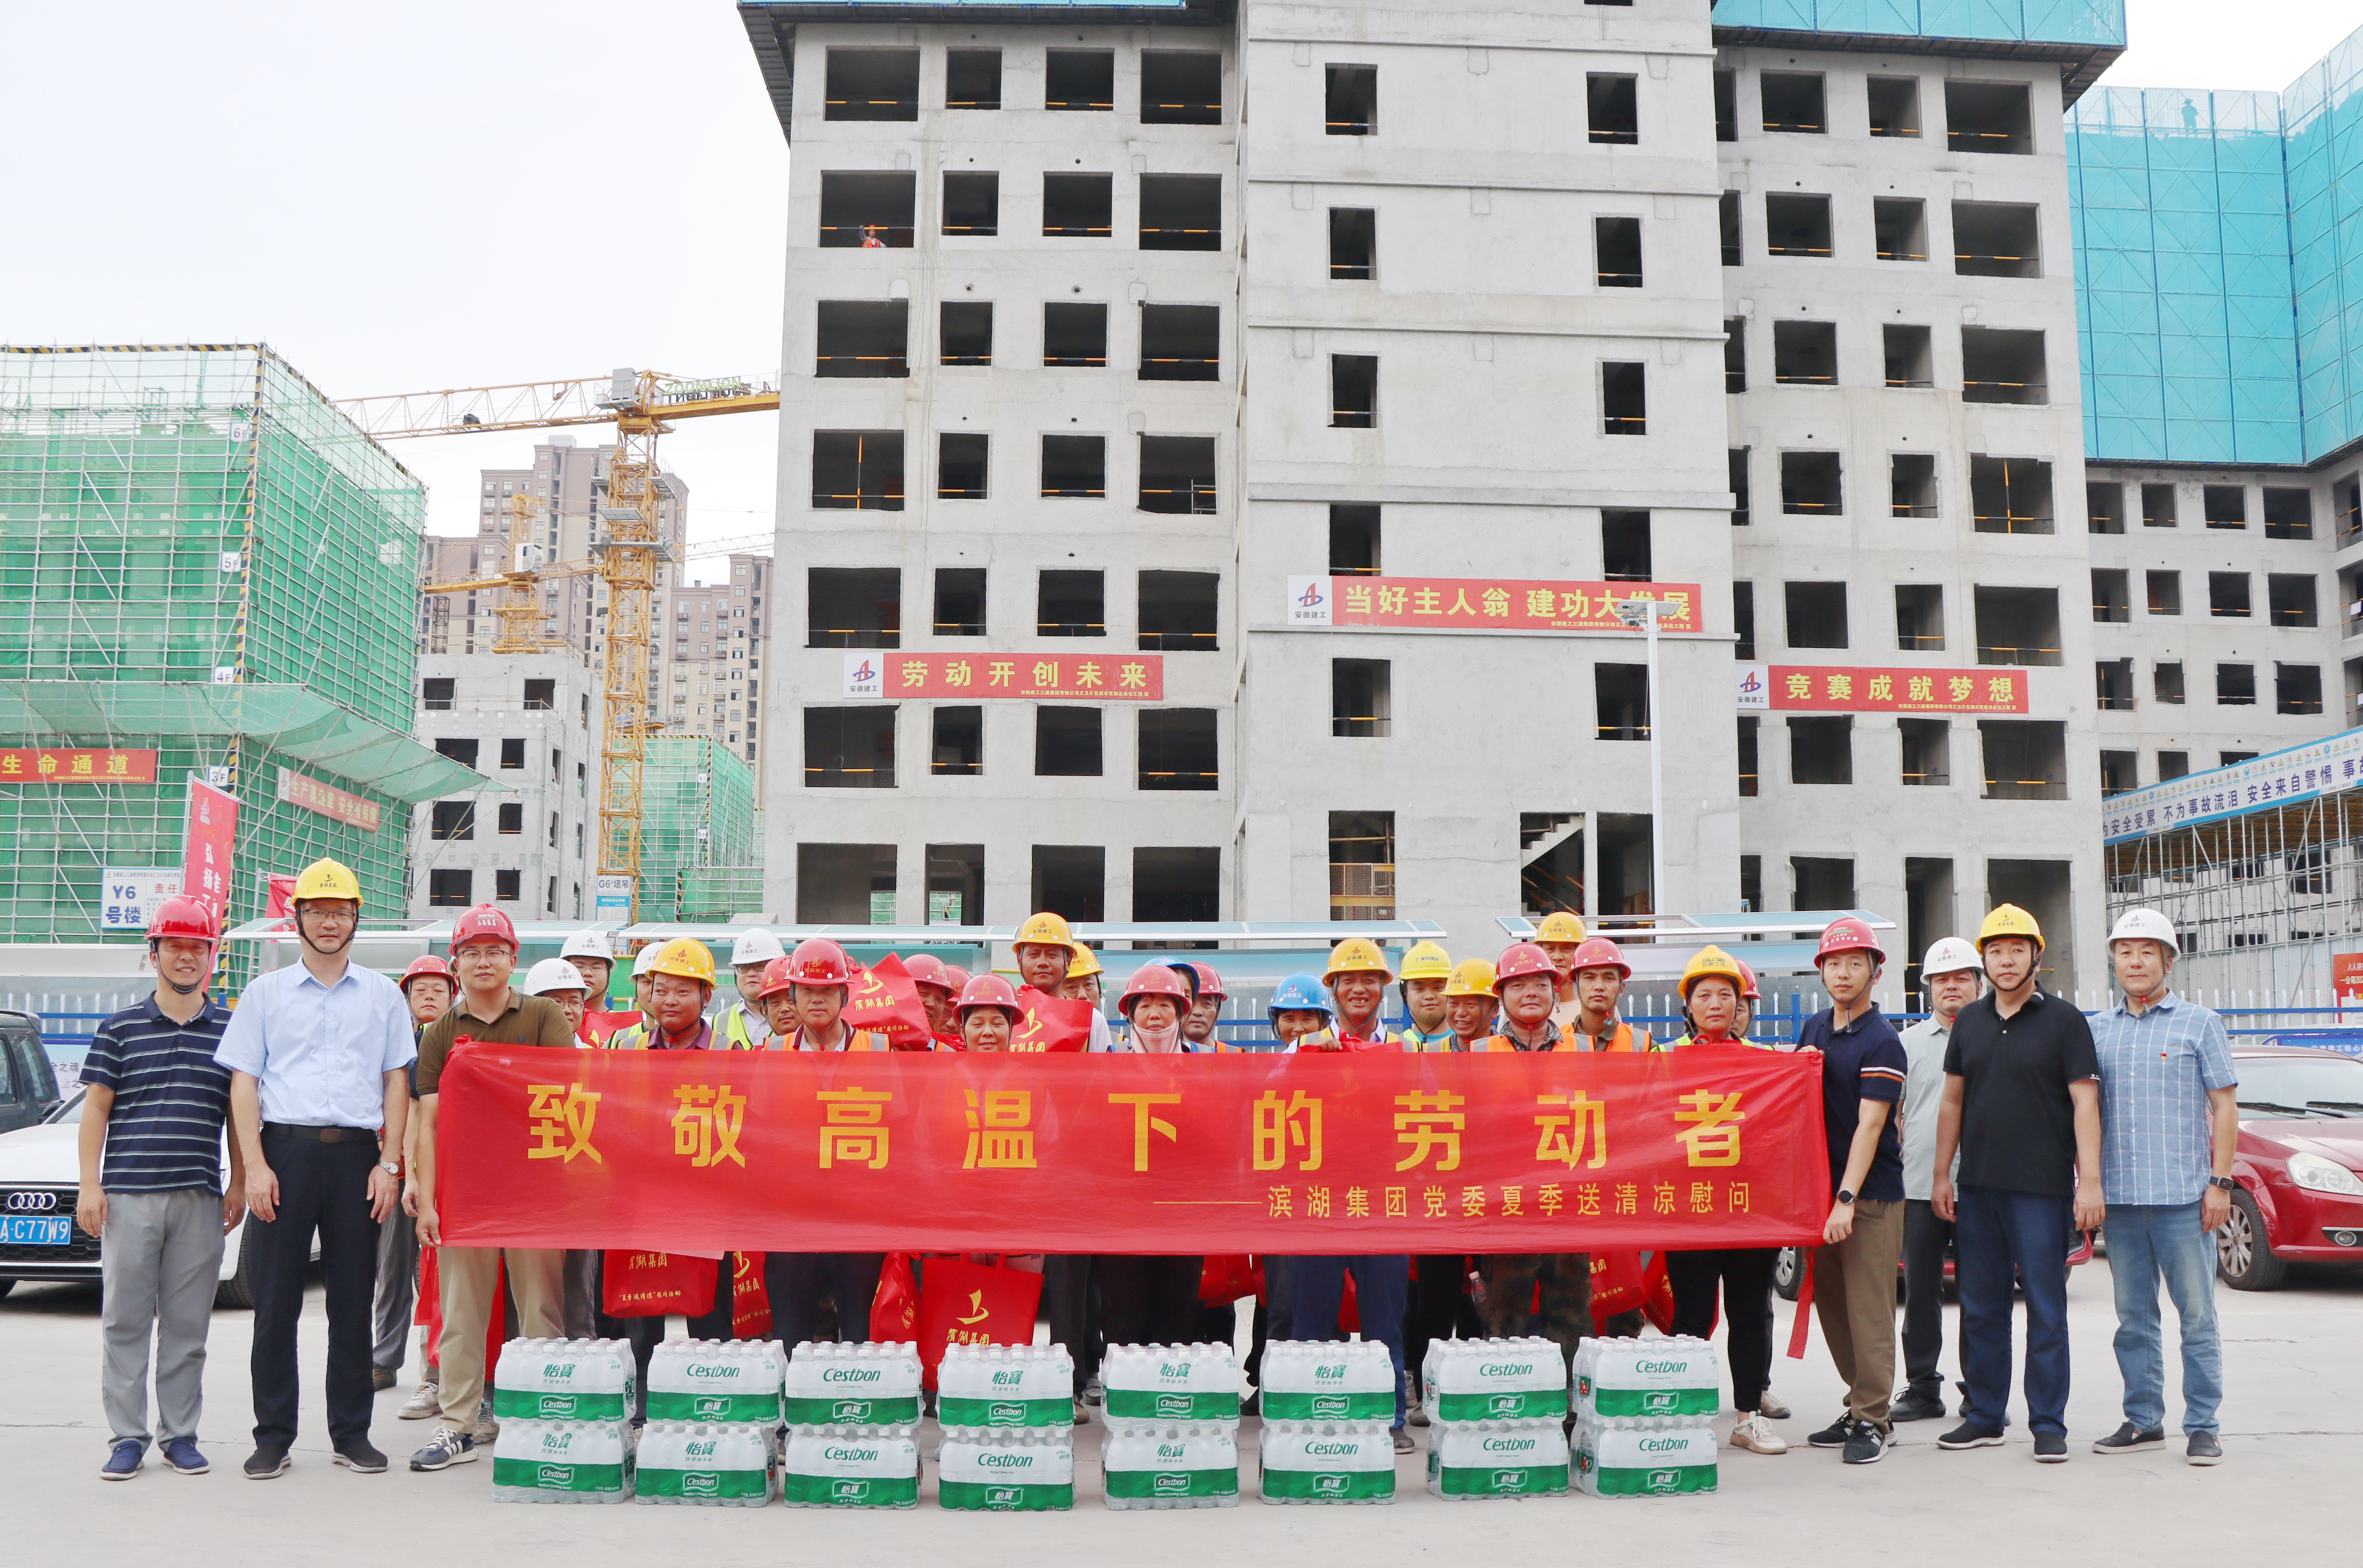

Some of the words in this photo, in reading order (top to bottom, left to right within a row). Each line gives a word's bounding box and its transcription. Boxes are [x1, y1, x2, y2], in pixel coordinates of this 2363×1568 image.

[664, 376, 741, 395] ZOOMLION
[1345, 586, 1511, 618] 当好主人翁
[1294, 611, 1327, 619] 安徽建工
[217, 672, 231, 682] 4F
[902, 660, 1147, 689] 劳动开创未来
[1785, 672, 2014, 703] 竞赛成就梦想
[2, 754, 129, 775] 生命通道
[211, 771, 226, 783] 3F
[2163, 790, 2238, 822] 不为事故流泪
[2247, 764, 2332, 804] 安全来自警惕
[291, 781, 334, 809] 生产莫违章
[339, 796, 376, 824] 安全有保障
[113, 885, 136, 899] Y6
[155, 884, 178, 894] 责任
[106, 906, 141, 924] 号楼
[1937, 954, 1957, 962] 安徽建工
[2347, 962, 2363, 971] 人人讲
[61, 1078, 86, 1088] 全之
[527, 1083, 1747, 1172] 致敬高温下的劳动者
[1268, 1180, 1751, 1219] 滨湖集团党委夏季送清凉慰问
